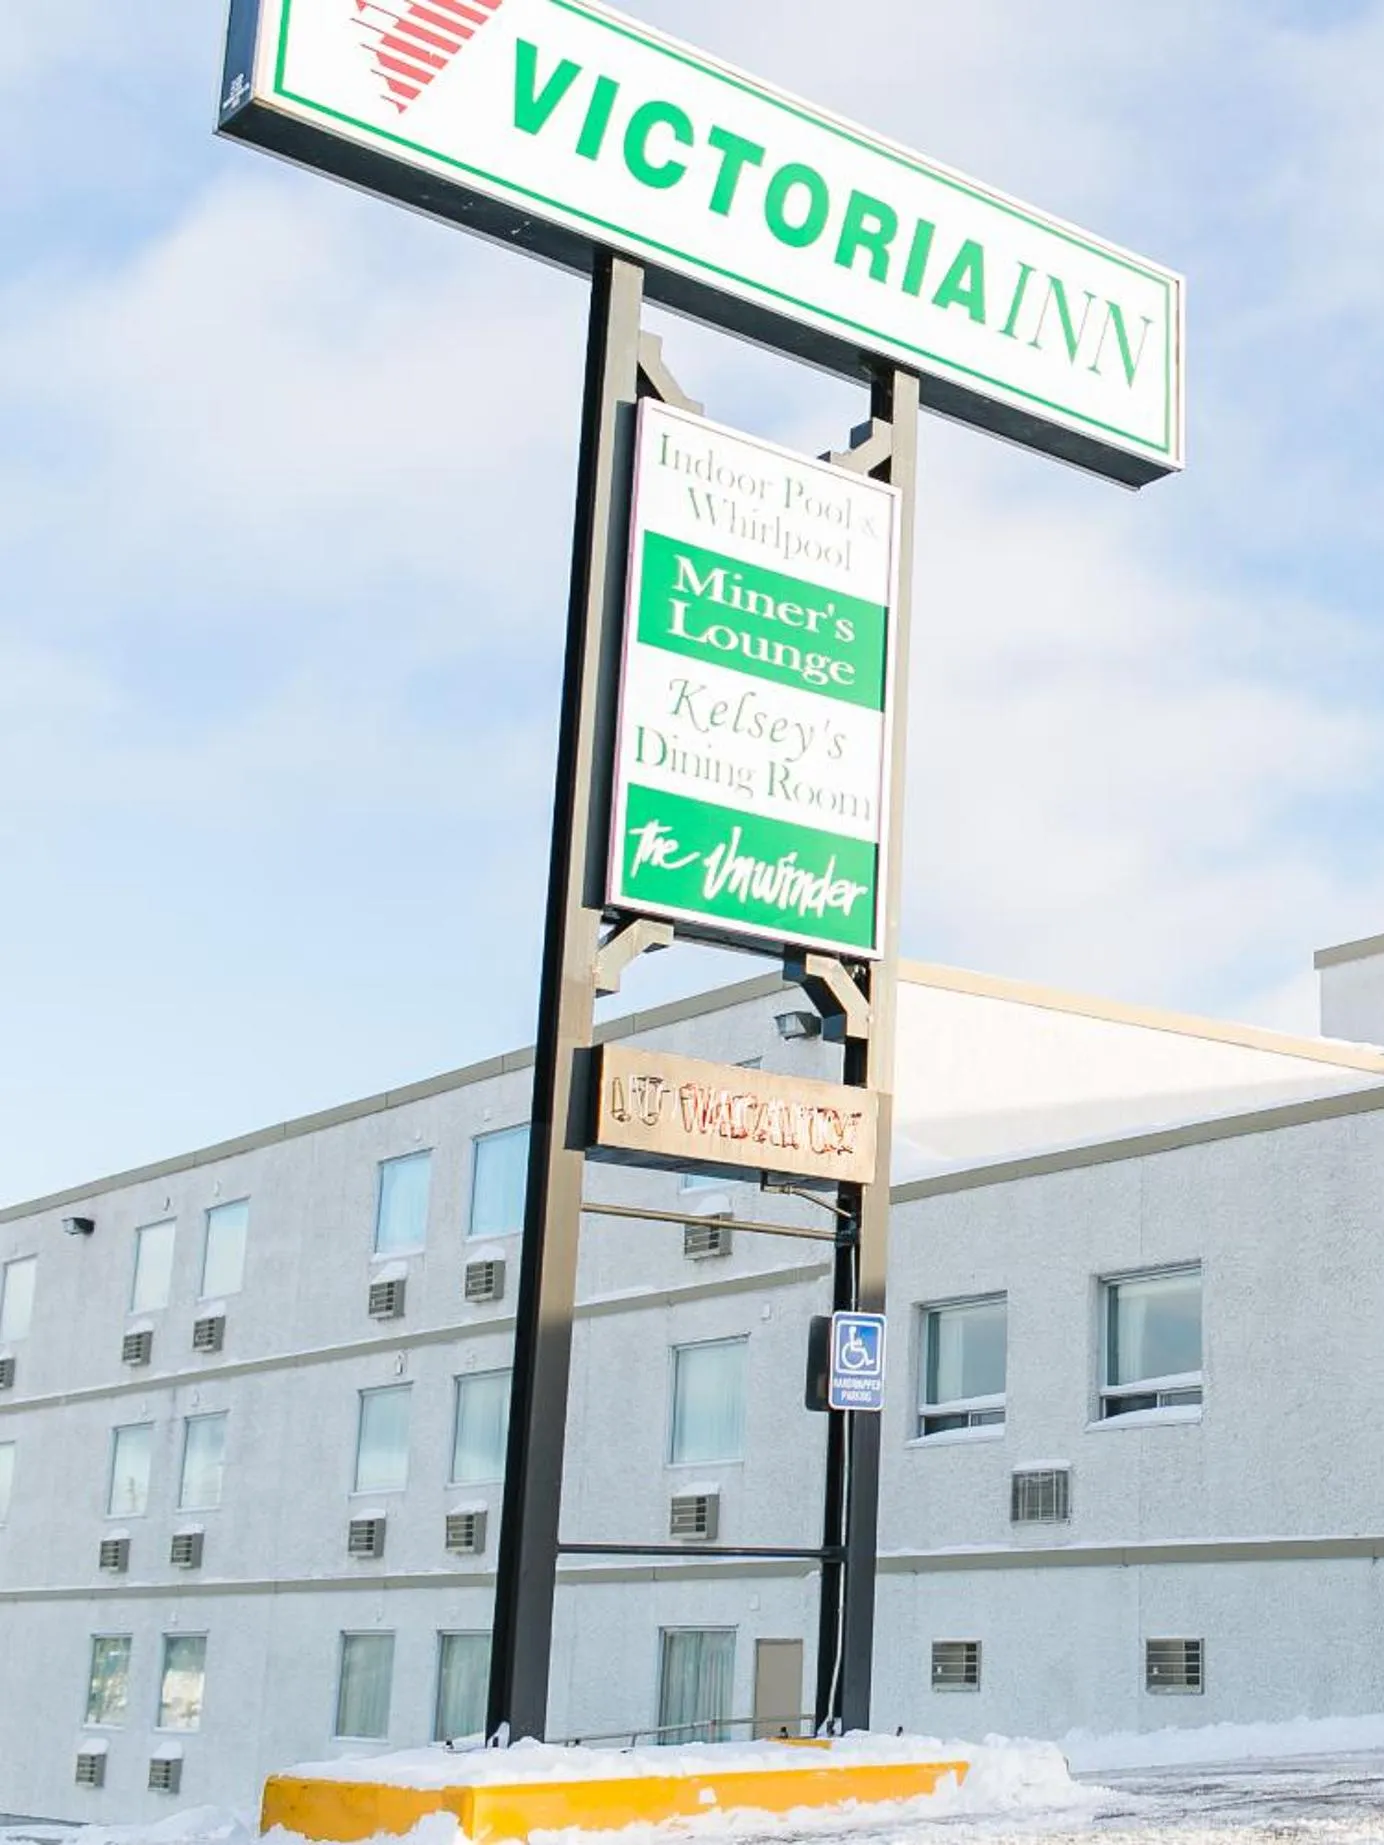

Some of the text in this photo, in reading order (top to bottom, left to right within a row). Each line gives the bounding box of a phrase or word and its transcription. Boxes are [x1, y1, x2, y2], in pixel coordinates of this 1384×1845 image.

[511, 36, 1154, 389] VICTORIA INN
[657, 432, 774, 500] Indoor
[783, 476, 852, 531] Pool
[687, 487, 851, 572] Whirlpool
[666, 597, 856, 685] Lounge
[671, 554, 856, 643] Miner's
[669, 678, 847, 763] Kelsey's
[634, 725, 871, 821] Dining Room
[703, 825, 869, 918] Unwinder
